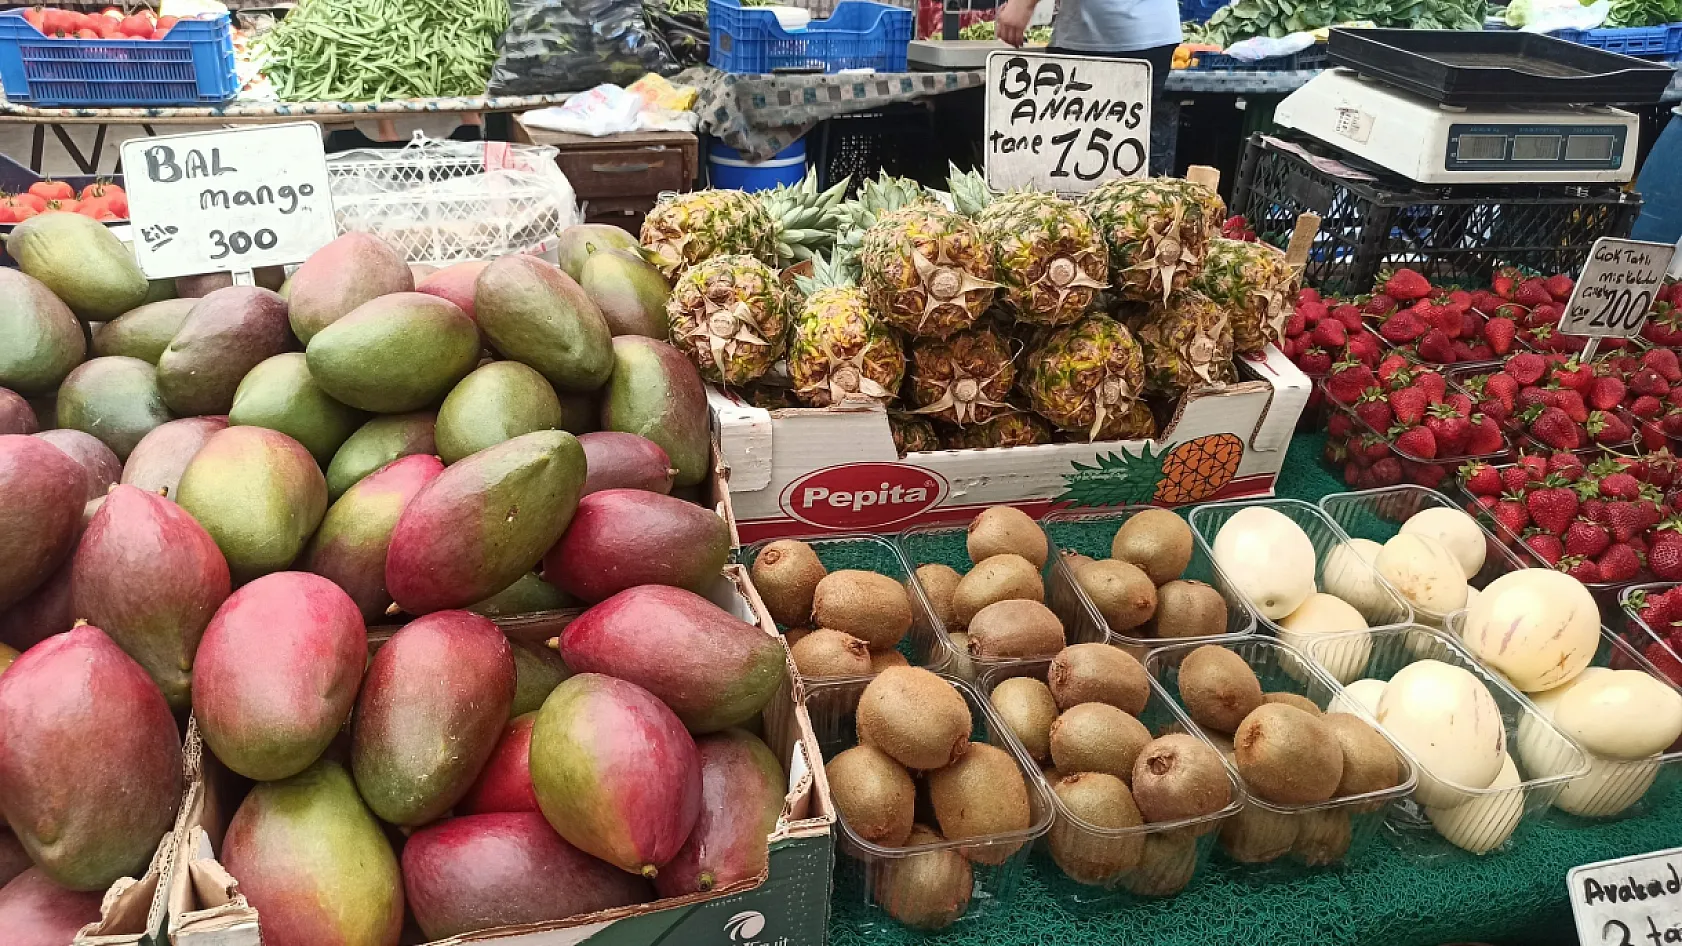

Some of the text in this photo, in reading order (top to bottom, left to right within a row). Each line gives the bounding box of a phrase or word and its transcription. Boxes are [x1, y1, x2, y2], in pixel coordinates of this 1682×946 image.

[999, 57, 1093, 99] BAL
[1010, 96, 1144, 129] ANANAS
[144, 145, 238, 182] BAL
[989, 127, 1147, 181] tane 150
[199, 183, 314, 214] mango
[208, 228, 278, 260] 300
[1589, 287, 1652, 330] 200
[802, 482, 928, 512] Pepita
[1583, 862, 1682, 907] Avakad
